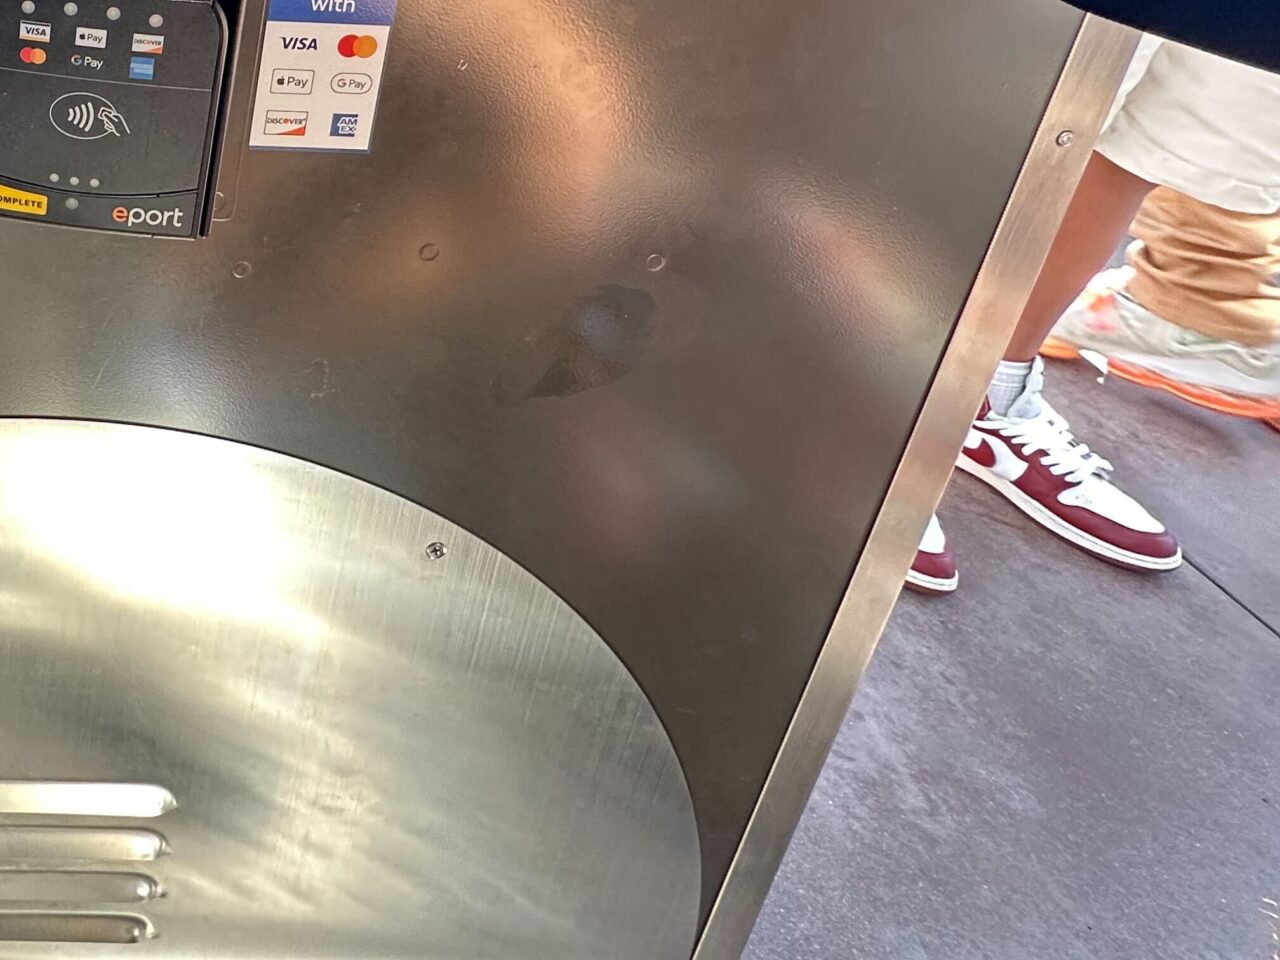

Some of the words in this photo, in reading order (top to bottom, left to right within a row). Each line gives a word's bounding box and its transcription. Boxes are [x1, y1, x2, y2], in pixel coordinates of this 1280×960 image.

[25, 26, 47, 37] VISA
[87, 33, 103, 45] Pay
[280, 36, 318, 50] VISA
[84, 56, 103, 70] Pay
[287, 76, 308, 89] Pay
[349, 79, 367, 90] Pay
[112, 206, 183, 227] eport
